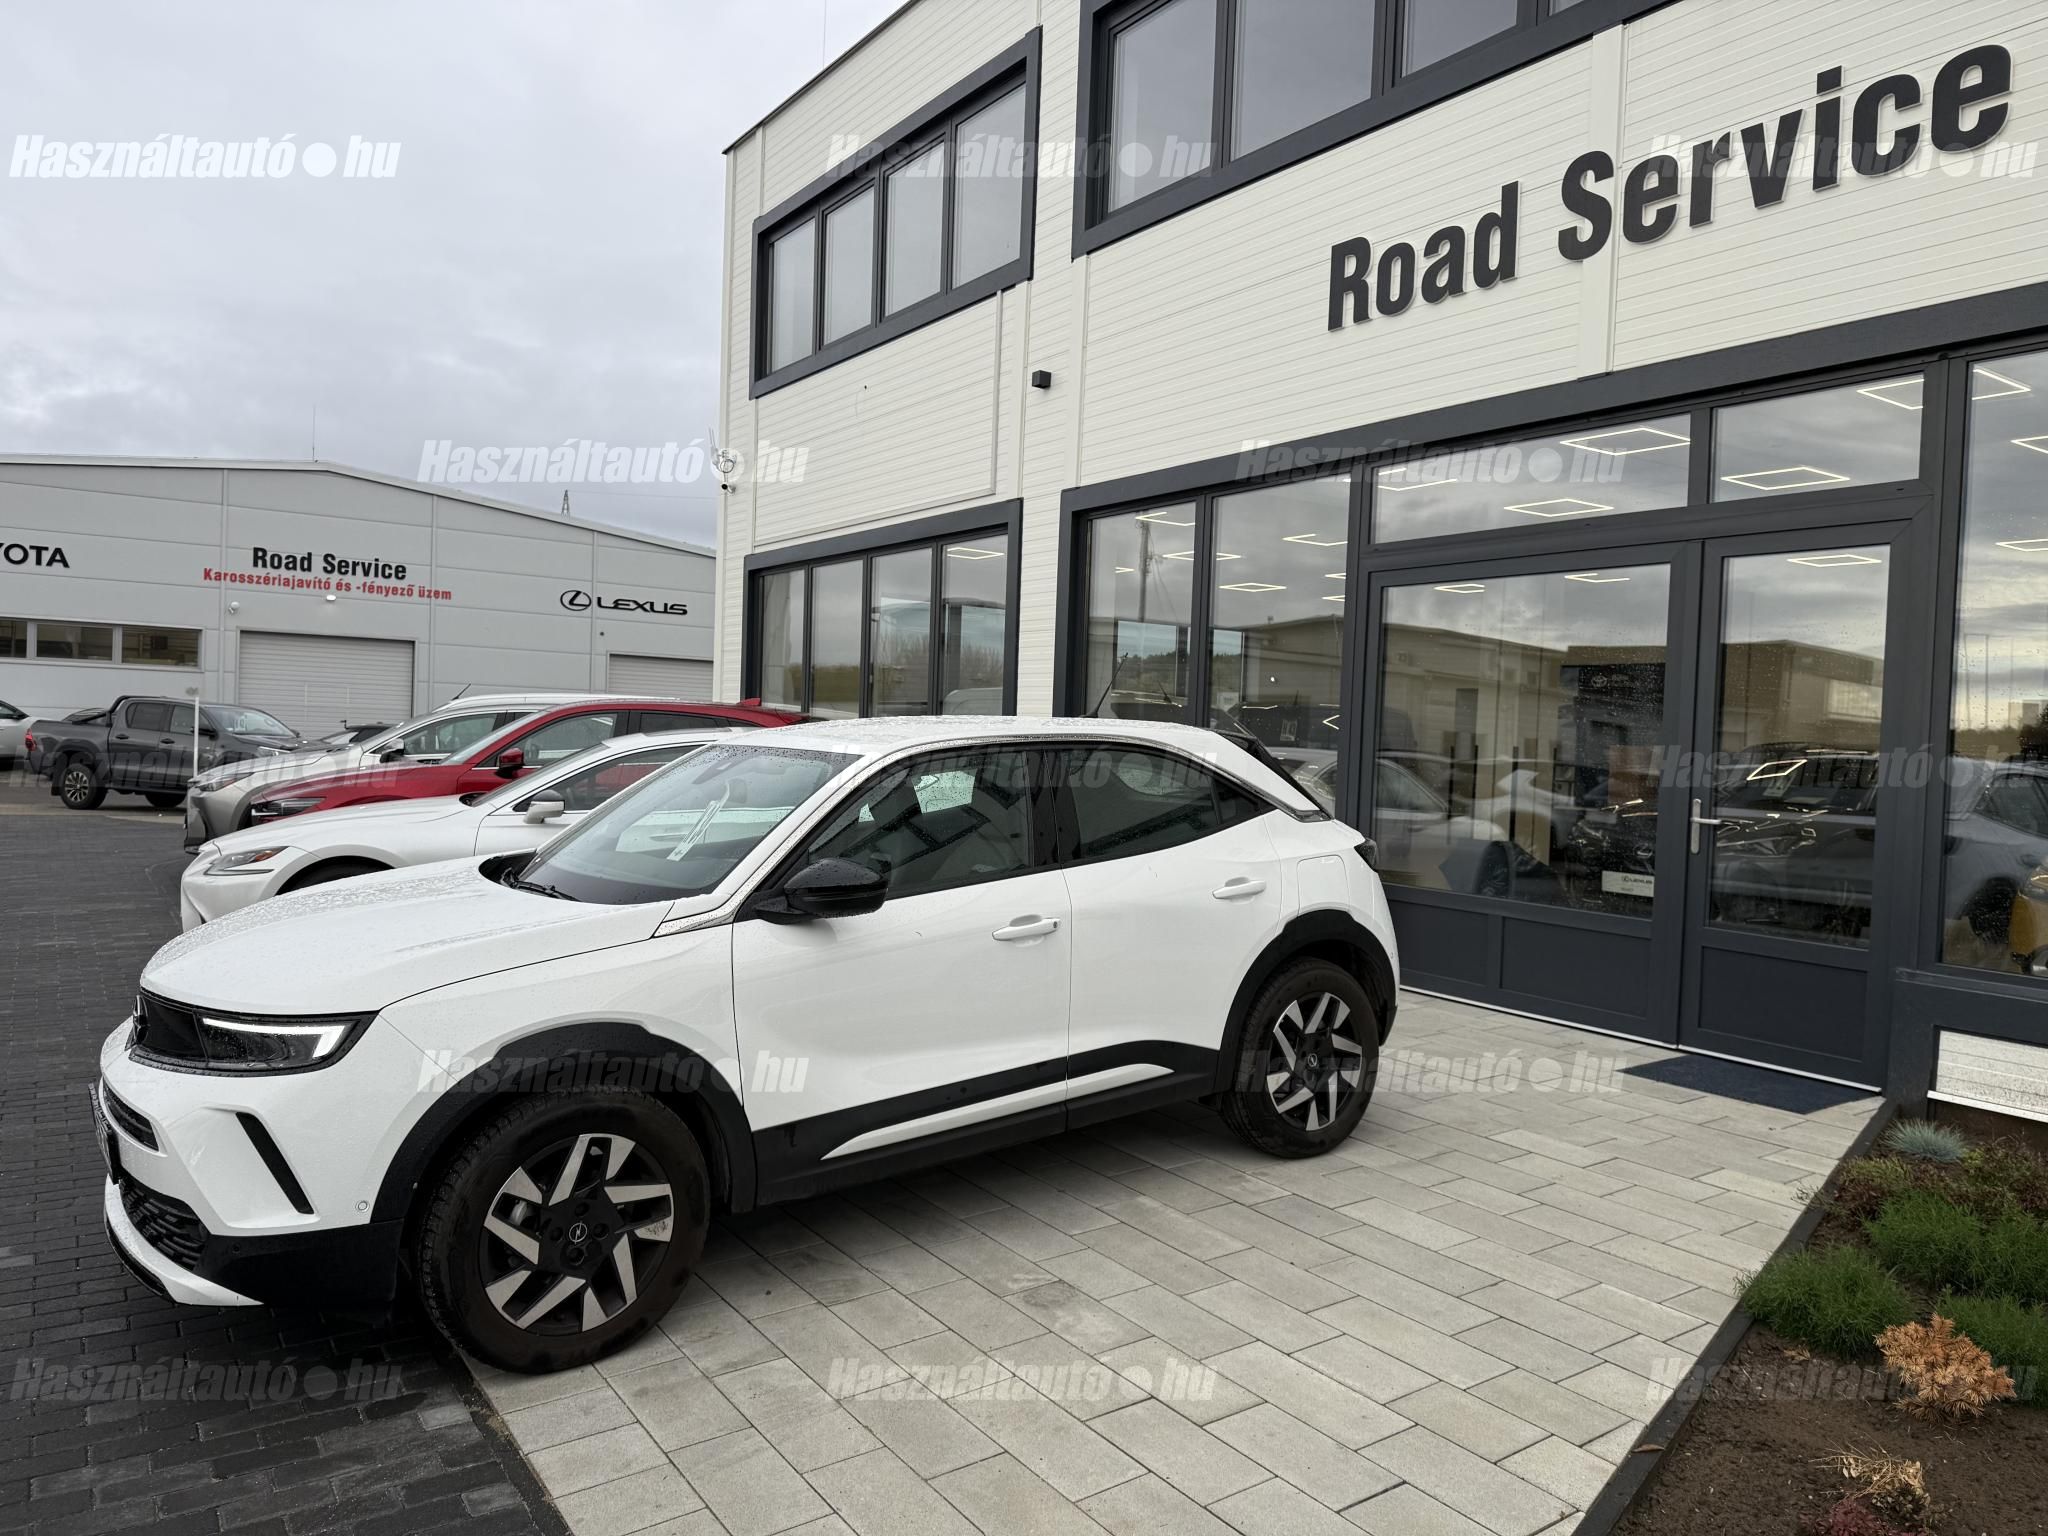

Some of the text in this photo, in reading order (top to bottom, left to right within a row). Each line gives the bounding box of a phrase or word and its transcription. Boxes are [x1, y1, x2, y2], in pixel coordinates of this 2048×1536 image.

[1328, 43, 2013, 332] Road Service
[0, 543, 70, 568] OTA
[252, 547, 407, 580] Road Service
[203, 568, 331, 590] Karosszériajavító
[335, 578, 352, 592] és
[418, 586, 452, 600] üzem
[597, 597, 688, 615] LEXUS
